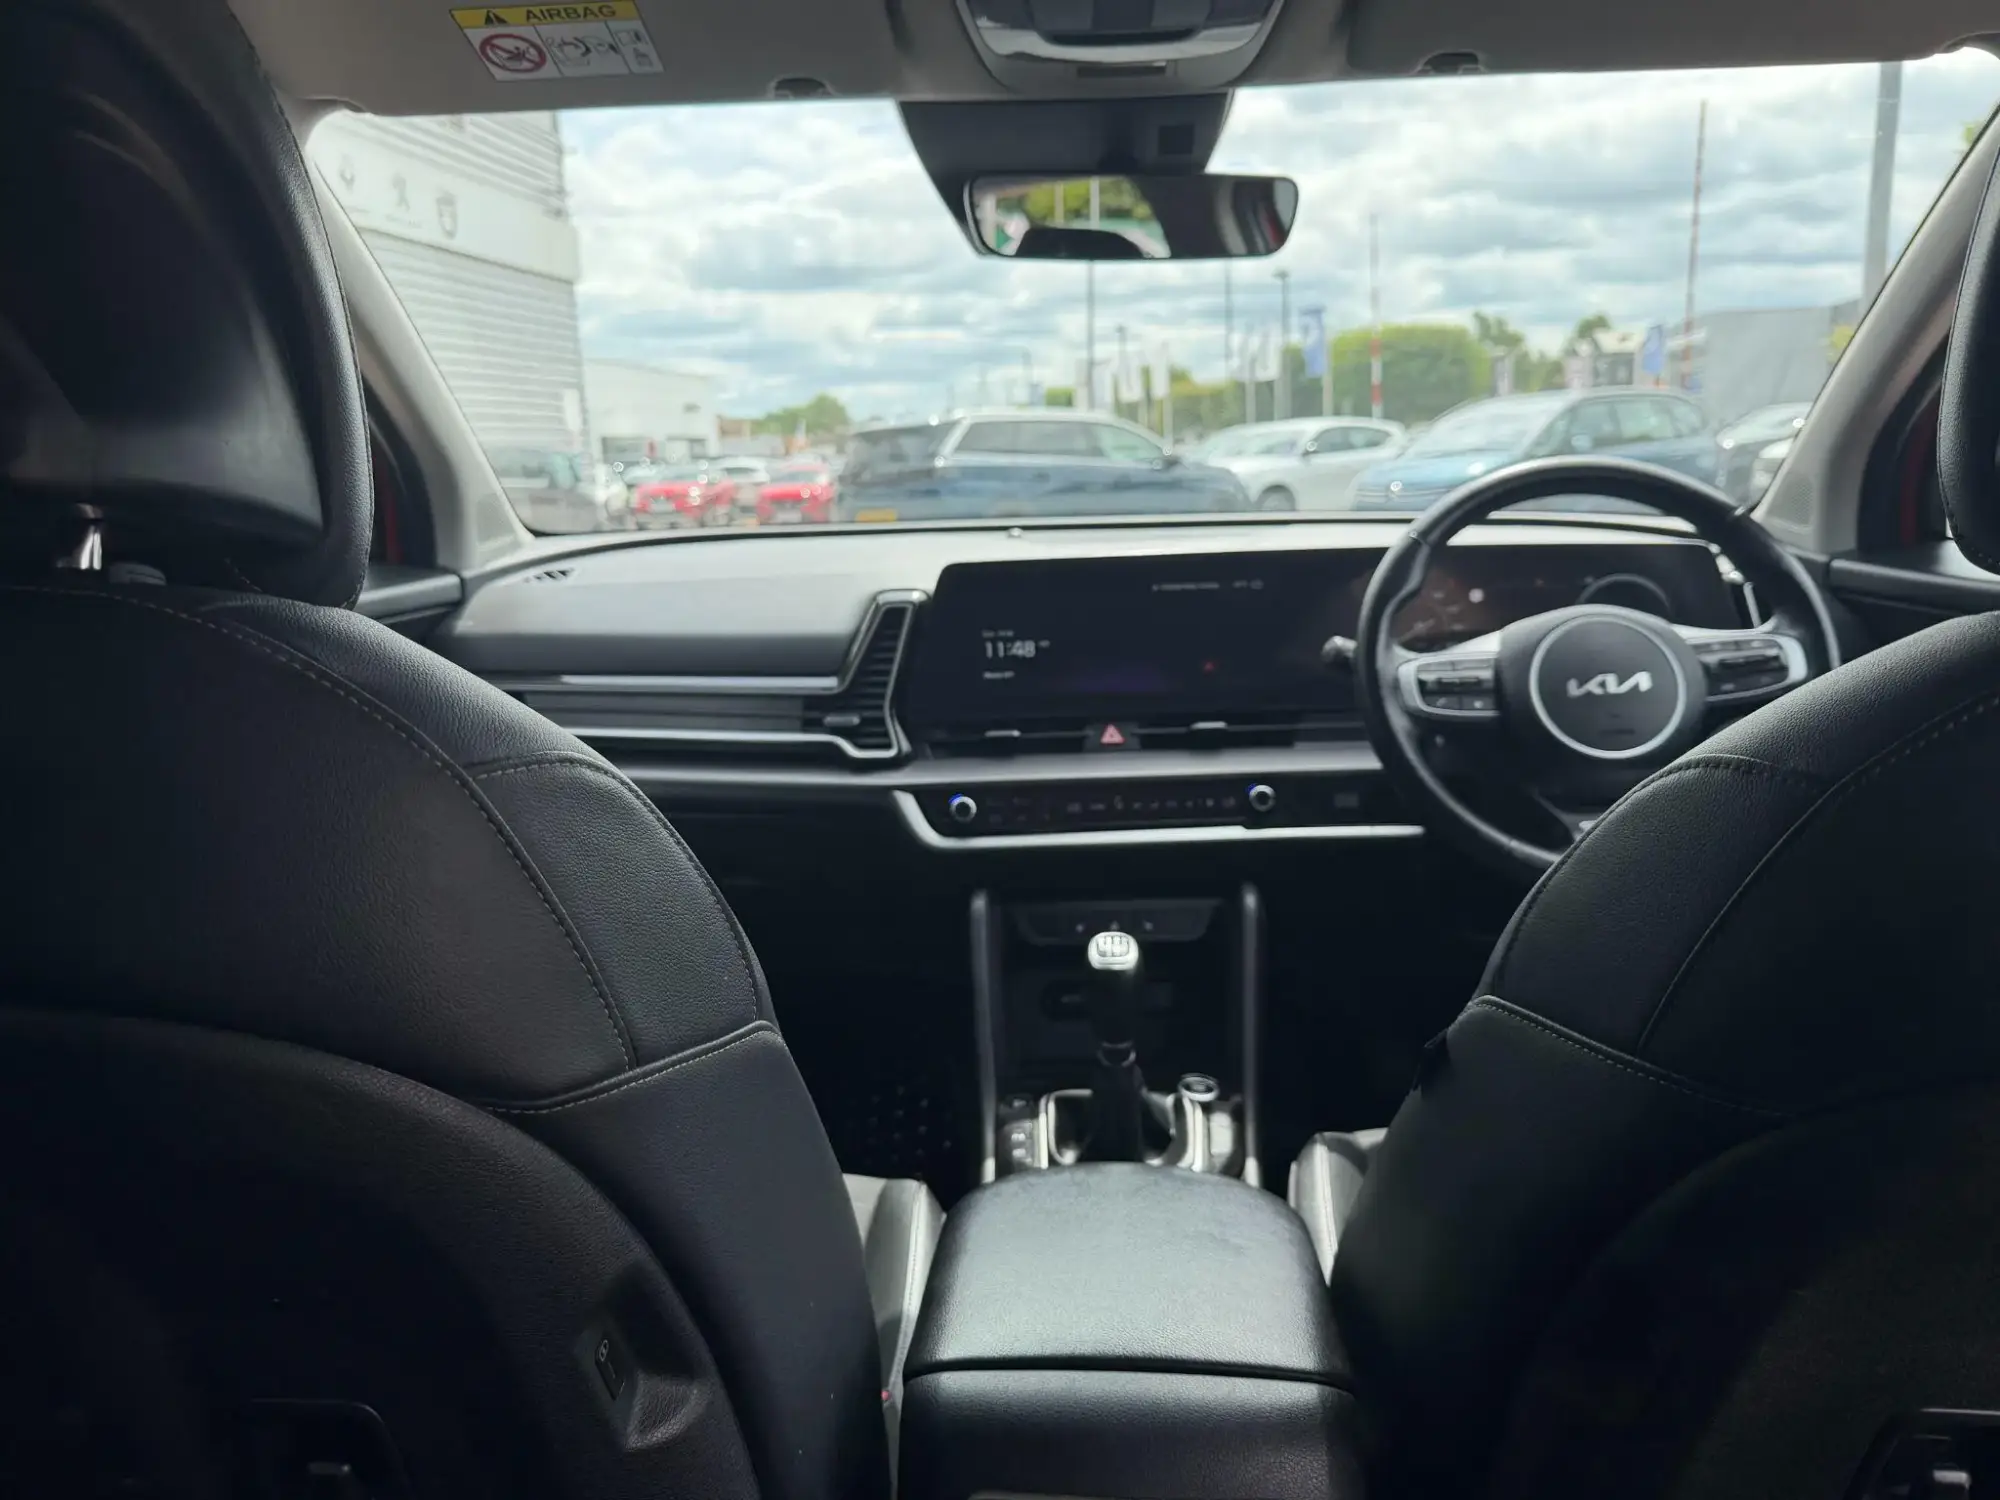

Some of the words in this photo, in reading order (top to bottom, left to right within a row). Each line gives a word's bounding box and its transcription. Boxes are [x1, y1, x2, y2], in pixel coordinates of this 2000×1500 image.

[526, 4, 616, 22] AIRBAG
[984, 640, 1036, 659] 11:48
[1566, 671, 1652, 698] KIA
